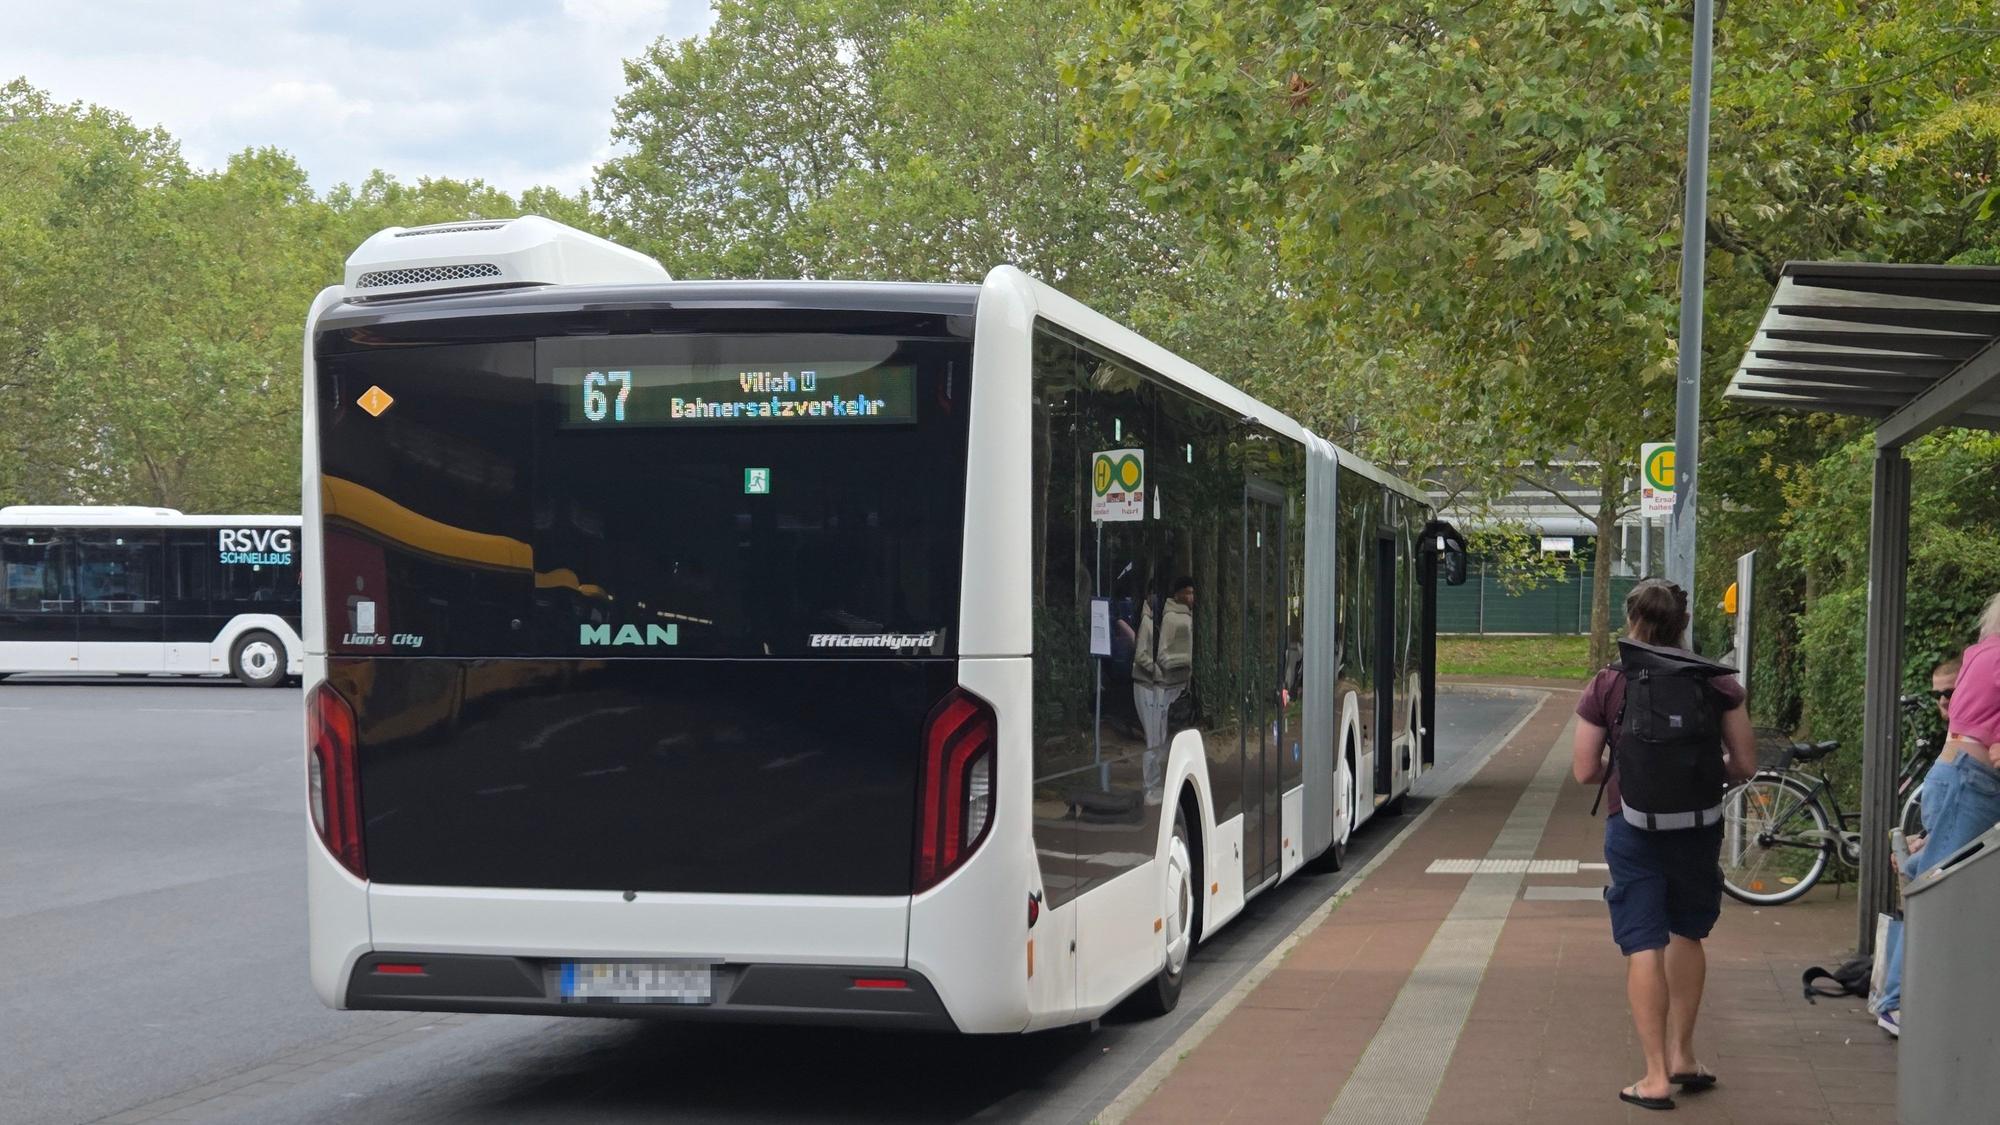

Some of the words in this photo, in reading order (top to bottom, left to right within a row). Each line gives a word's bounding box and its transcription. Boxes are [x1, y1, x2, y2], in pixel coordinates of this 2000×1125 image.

[739, 371, 796, 392] Vilich
[583, 371, 631, 421] 67
[671, 394, 885, 418] Bahnersatzverkehr
[219, 529, 291, 552] RSVG
[220, 552, 291, 565] SCHNELLBUS
[342, 633, 387, 646] Lion's
[391, 633, 423, 648] City
[580, 624, 678, 645] MAN
[811, 634, 935, 650] EfficientHybrid
